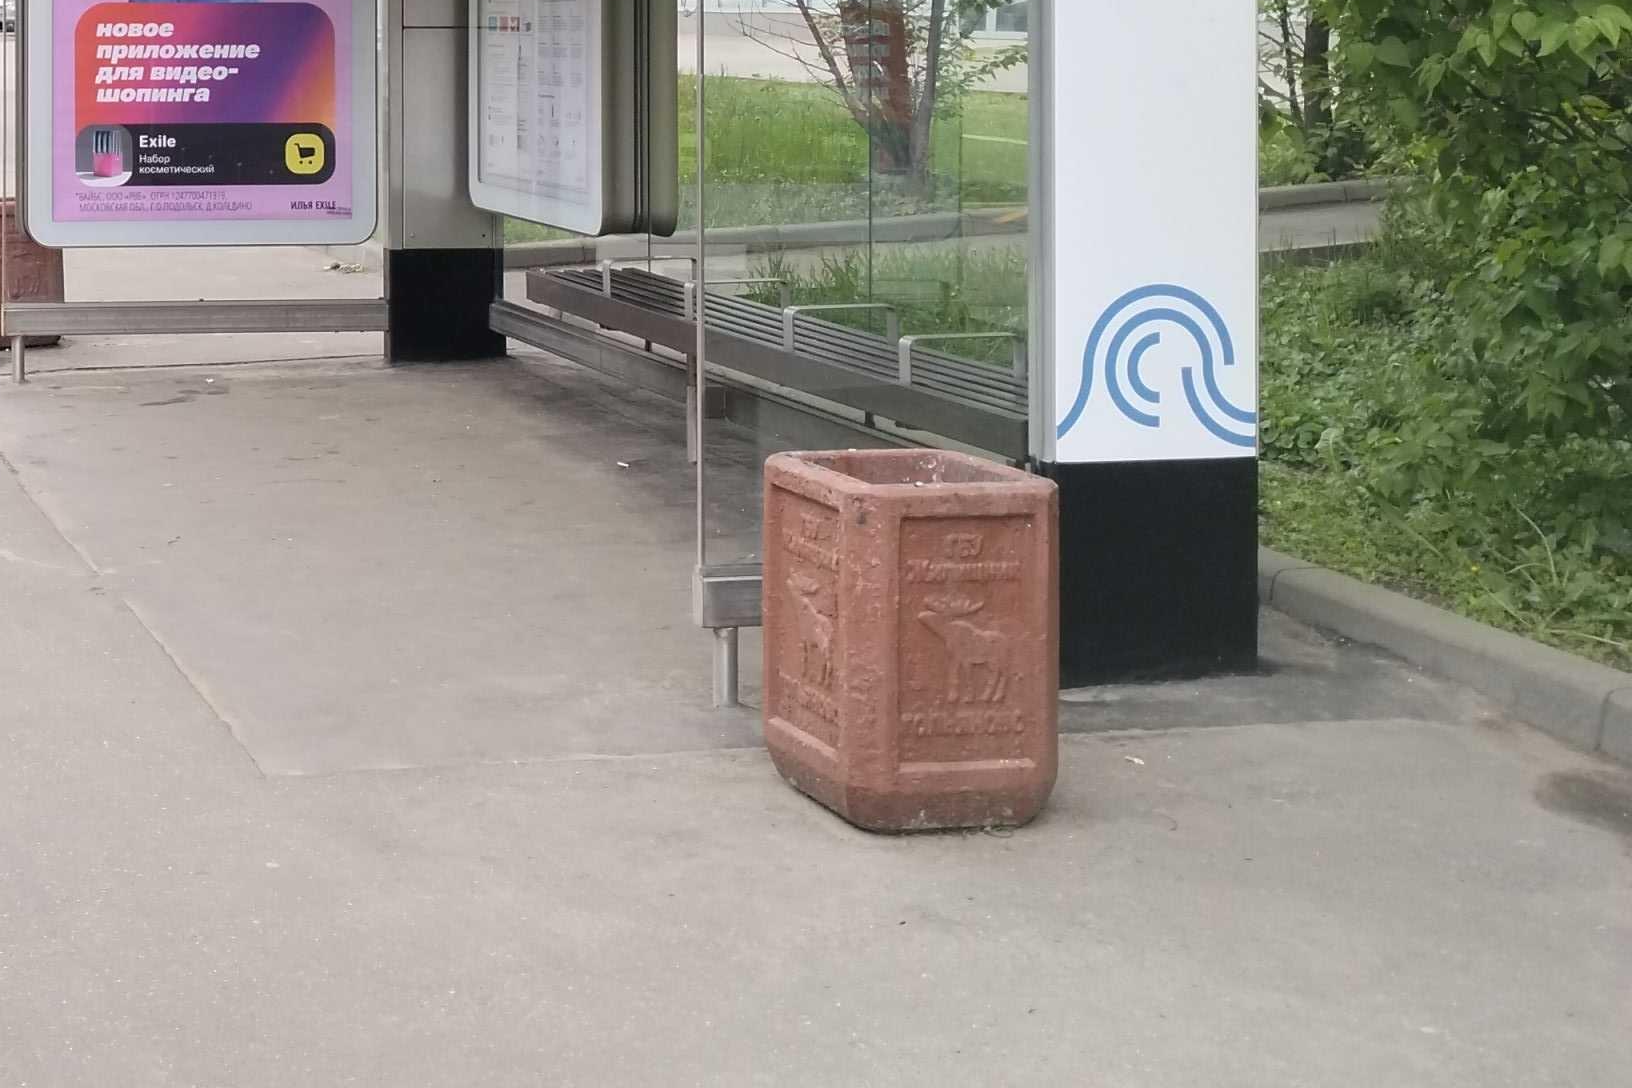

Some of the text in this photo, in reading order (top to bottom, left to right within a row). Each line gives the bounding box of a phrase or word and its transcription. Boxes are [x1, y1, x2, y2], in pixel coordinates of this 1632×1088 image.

[96, 22, 175, 38] новое
[96, 44, 261, 64] приложение
[95, 65, 239, 84] для видео-
[96, 87, 211, 103] шопинга
[139, 135, 177, 148] Exile
[139, 154, 171, 165] Набор
[139, 164, 215, 175] косметический
[290, 200, 336, 210] ИЛЬЯ EXILE
